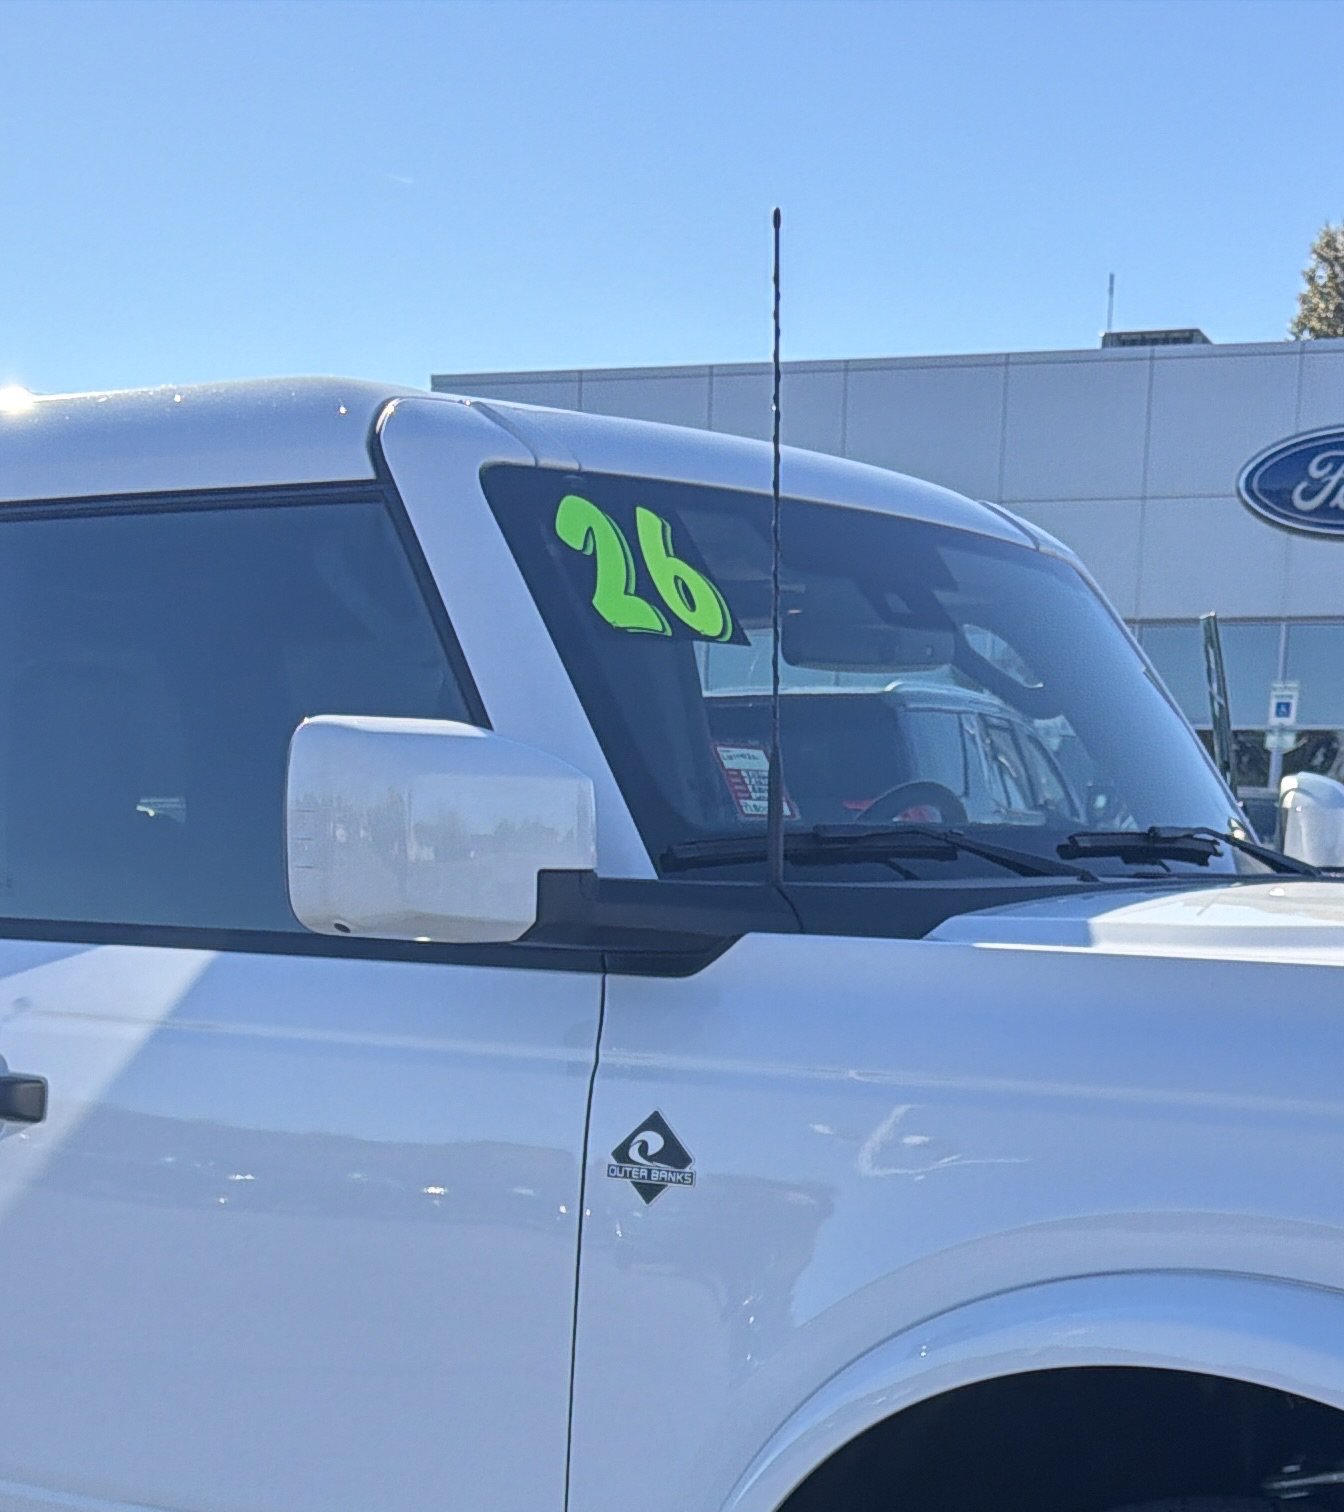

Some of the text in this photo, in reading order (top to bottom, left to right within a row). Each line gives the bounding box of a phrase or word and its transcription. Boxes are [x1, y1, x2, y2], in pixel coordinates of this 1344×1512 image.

[555, 494, 733, 642] 26
[609, 1166, 692, 1183] OUTER BANKS
